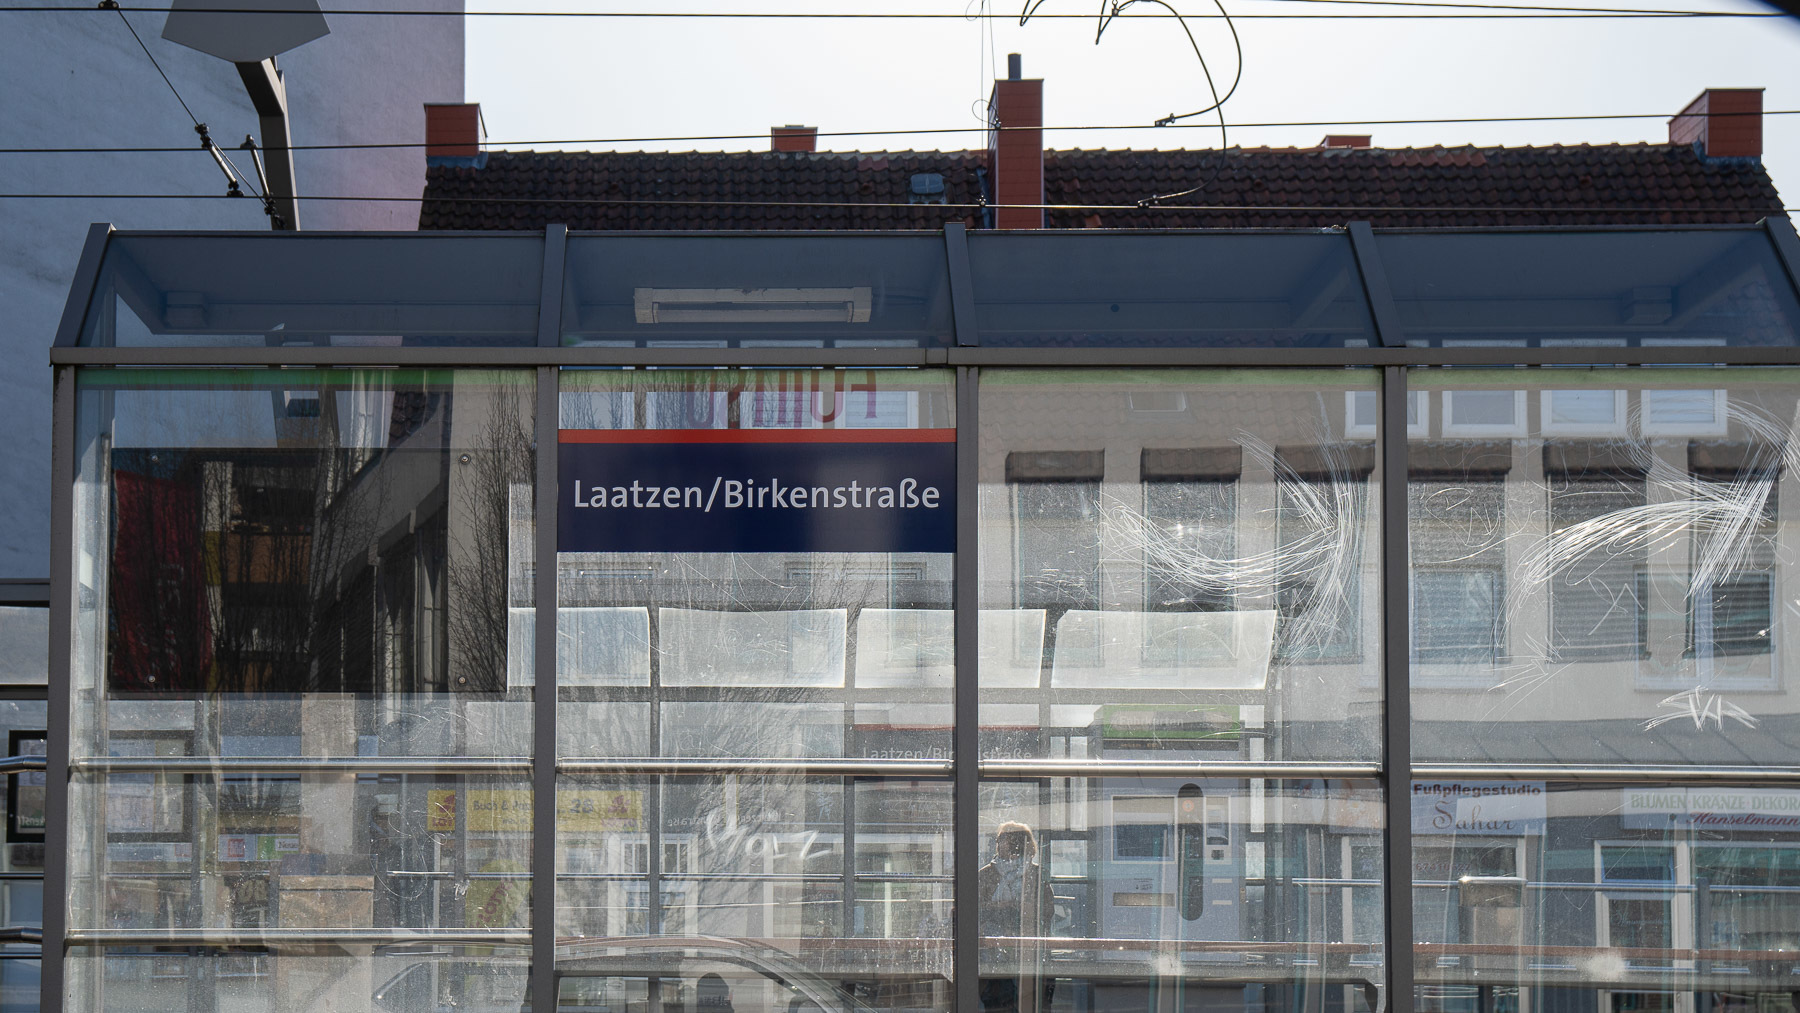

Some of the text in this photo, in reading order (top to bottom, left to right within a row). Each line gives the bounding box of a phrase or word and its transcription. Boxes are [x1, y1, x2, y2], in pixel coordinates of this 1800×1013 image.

[573, 476, 941, 513] Laatzen/Birkenstraße
[1413, 784, 1541, 797] Fußpflegestudio
[1631, 791, 1800, 811] BLUMEN KRÄNZE DEKOR
[1432, 800, 1517, 831] Sahar
[1686, 811, 1800, 827] Hanselmann
